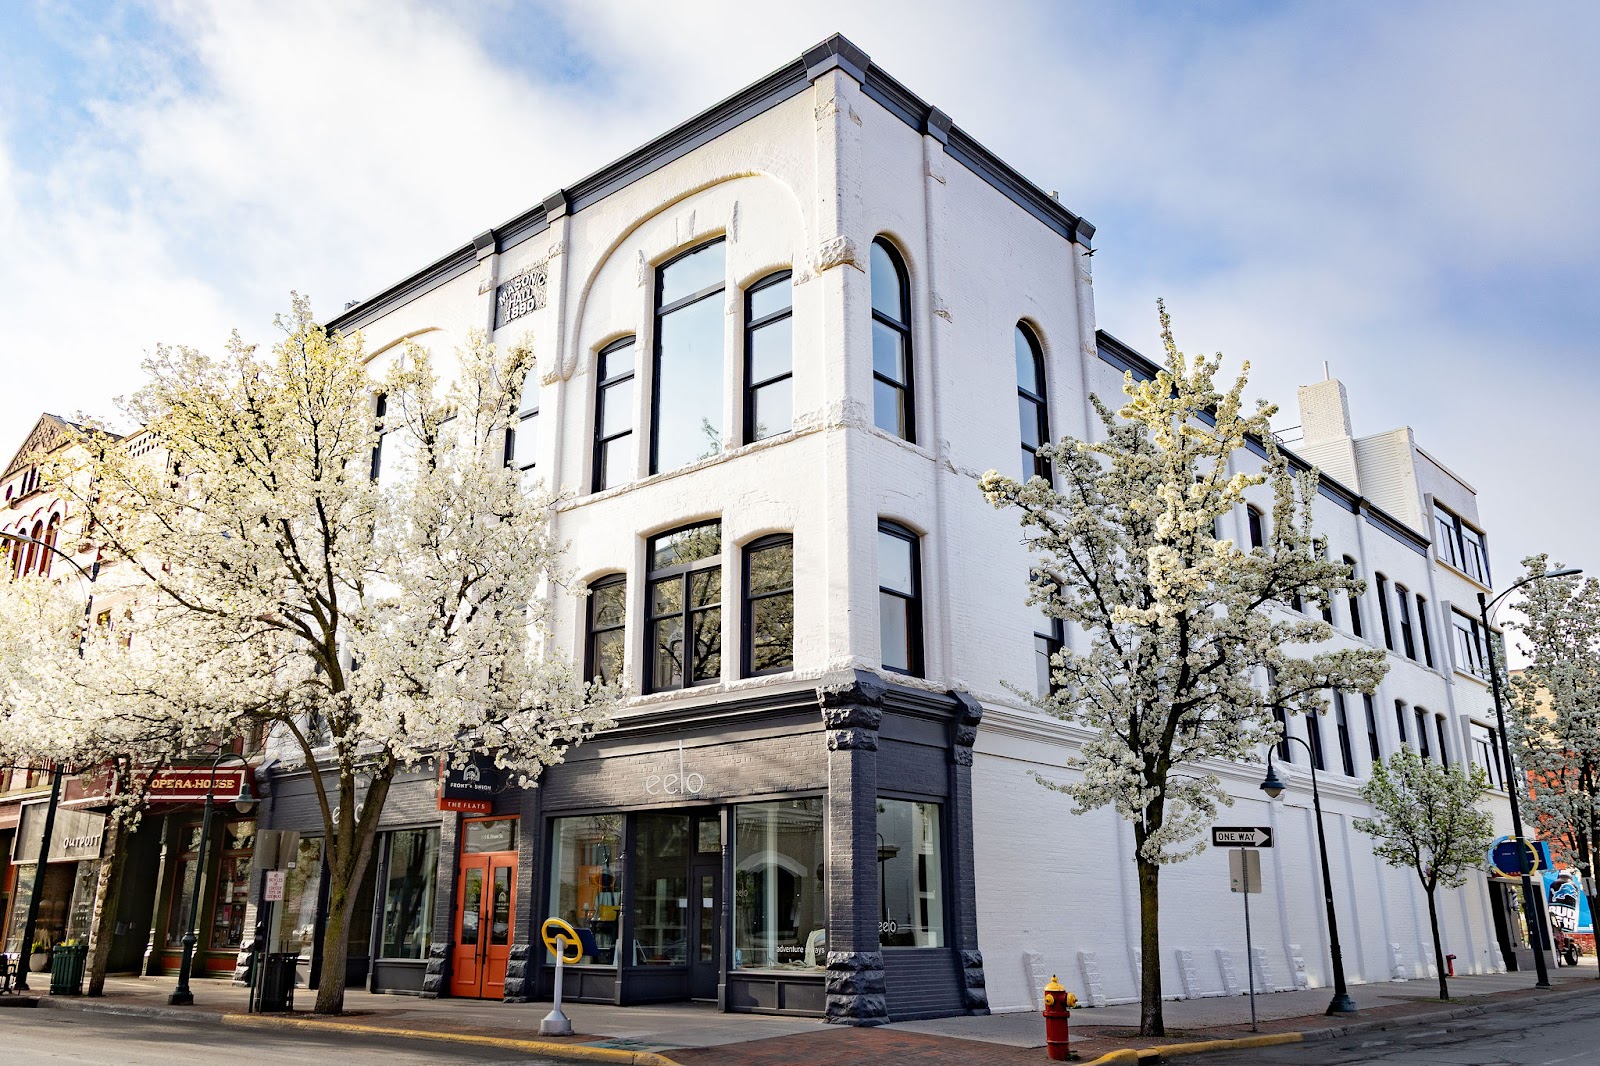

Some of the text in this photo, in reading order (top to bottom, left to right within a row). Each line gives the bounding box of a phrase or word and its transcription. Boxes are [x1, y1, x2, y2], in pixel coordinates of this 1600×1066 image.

[499, 272, 546, 306] MASONIC
[508, 287, 534, 310] HALL
[646, 739, 704, 795] eelo
[151, 779, 192, 789] OPERA
[463, 802, 486, 810] FLATS
[63, 834, 100, 849] OUTPOST
[1218, 832, 1255, 841] ONE WAY
[776, 945, 804, 953] adventure
